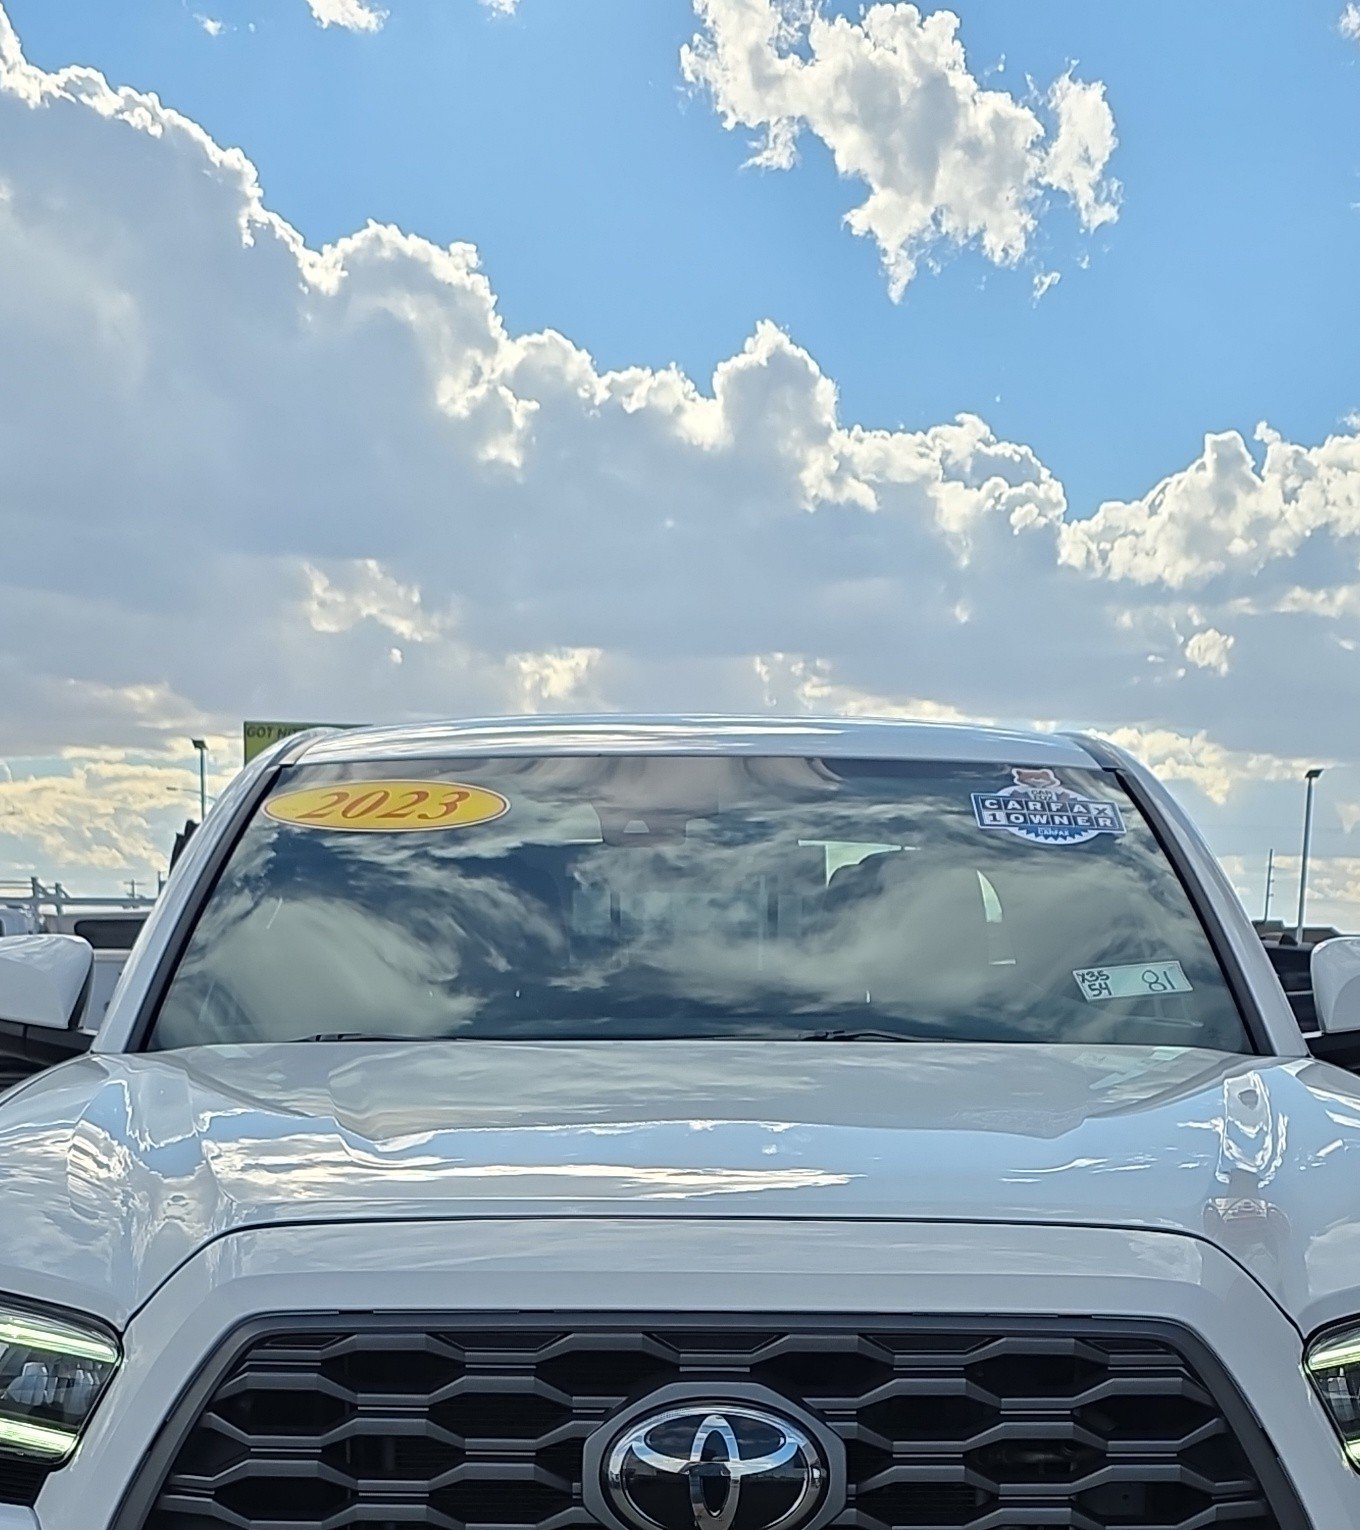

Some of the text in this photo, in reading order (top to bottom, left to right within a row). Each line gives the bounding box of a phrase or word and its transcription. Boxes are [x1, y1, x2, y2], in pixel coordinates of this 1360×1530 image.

[295, 790, 471, 820] 2023
[984, 799, 1109, 815] CARFAX
[989, 812, 1113, 827] 1 OWNER
[1088, 981, 1112, 997] 54
[1142, 970, 1176, 992] 81
